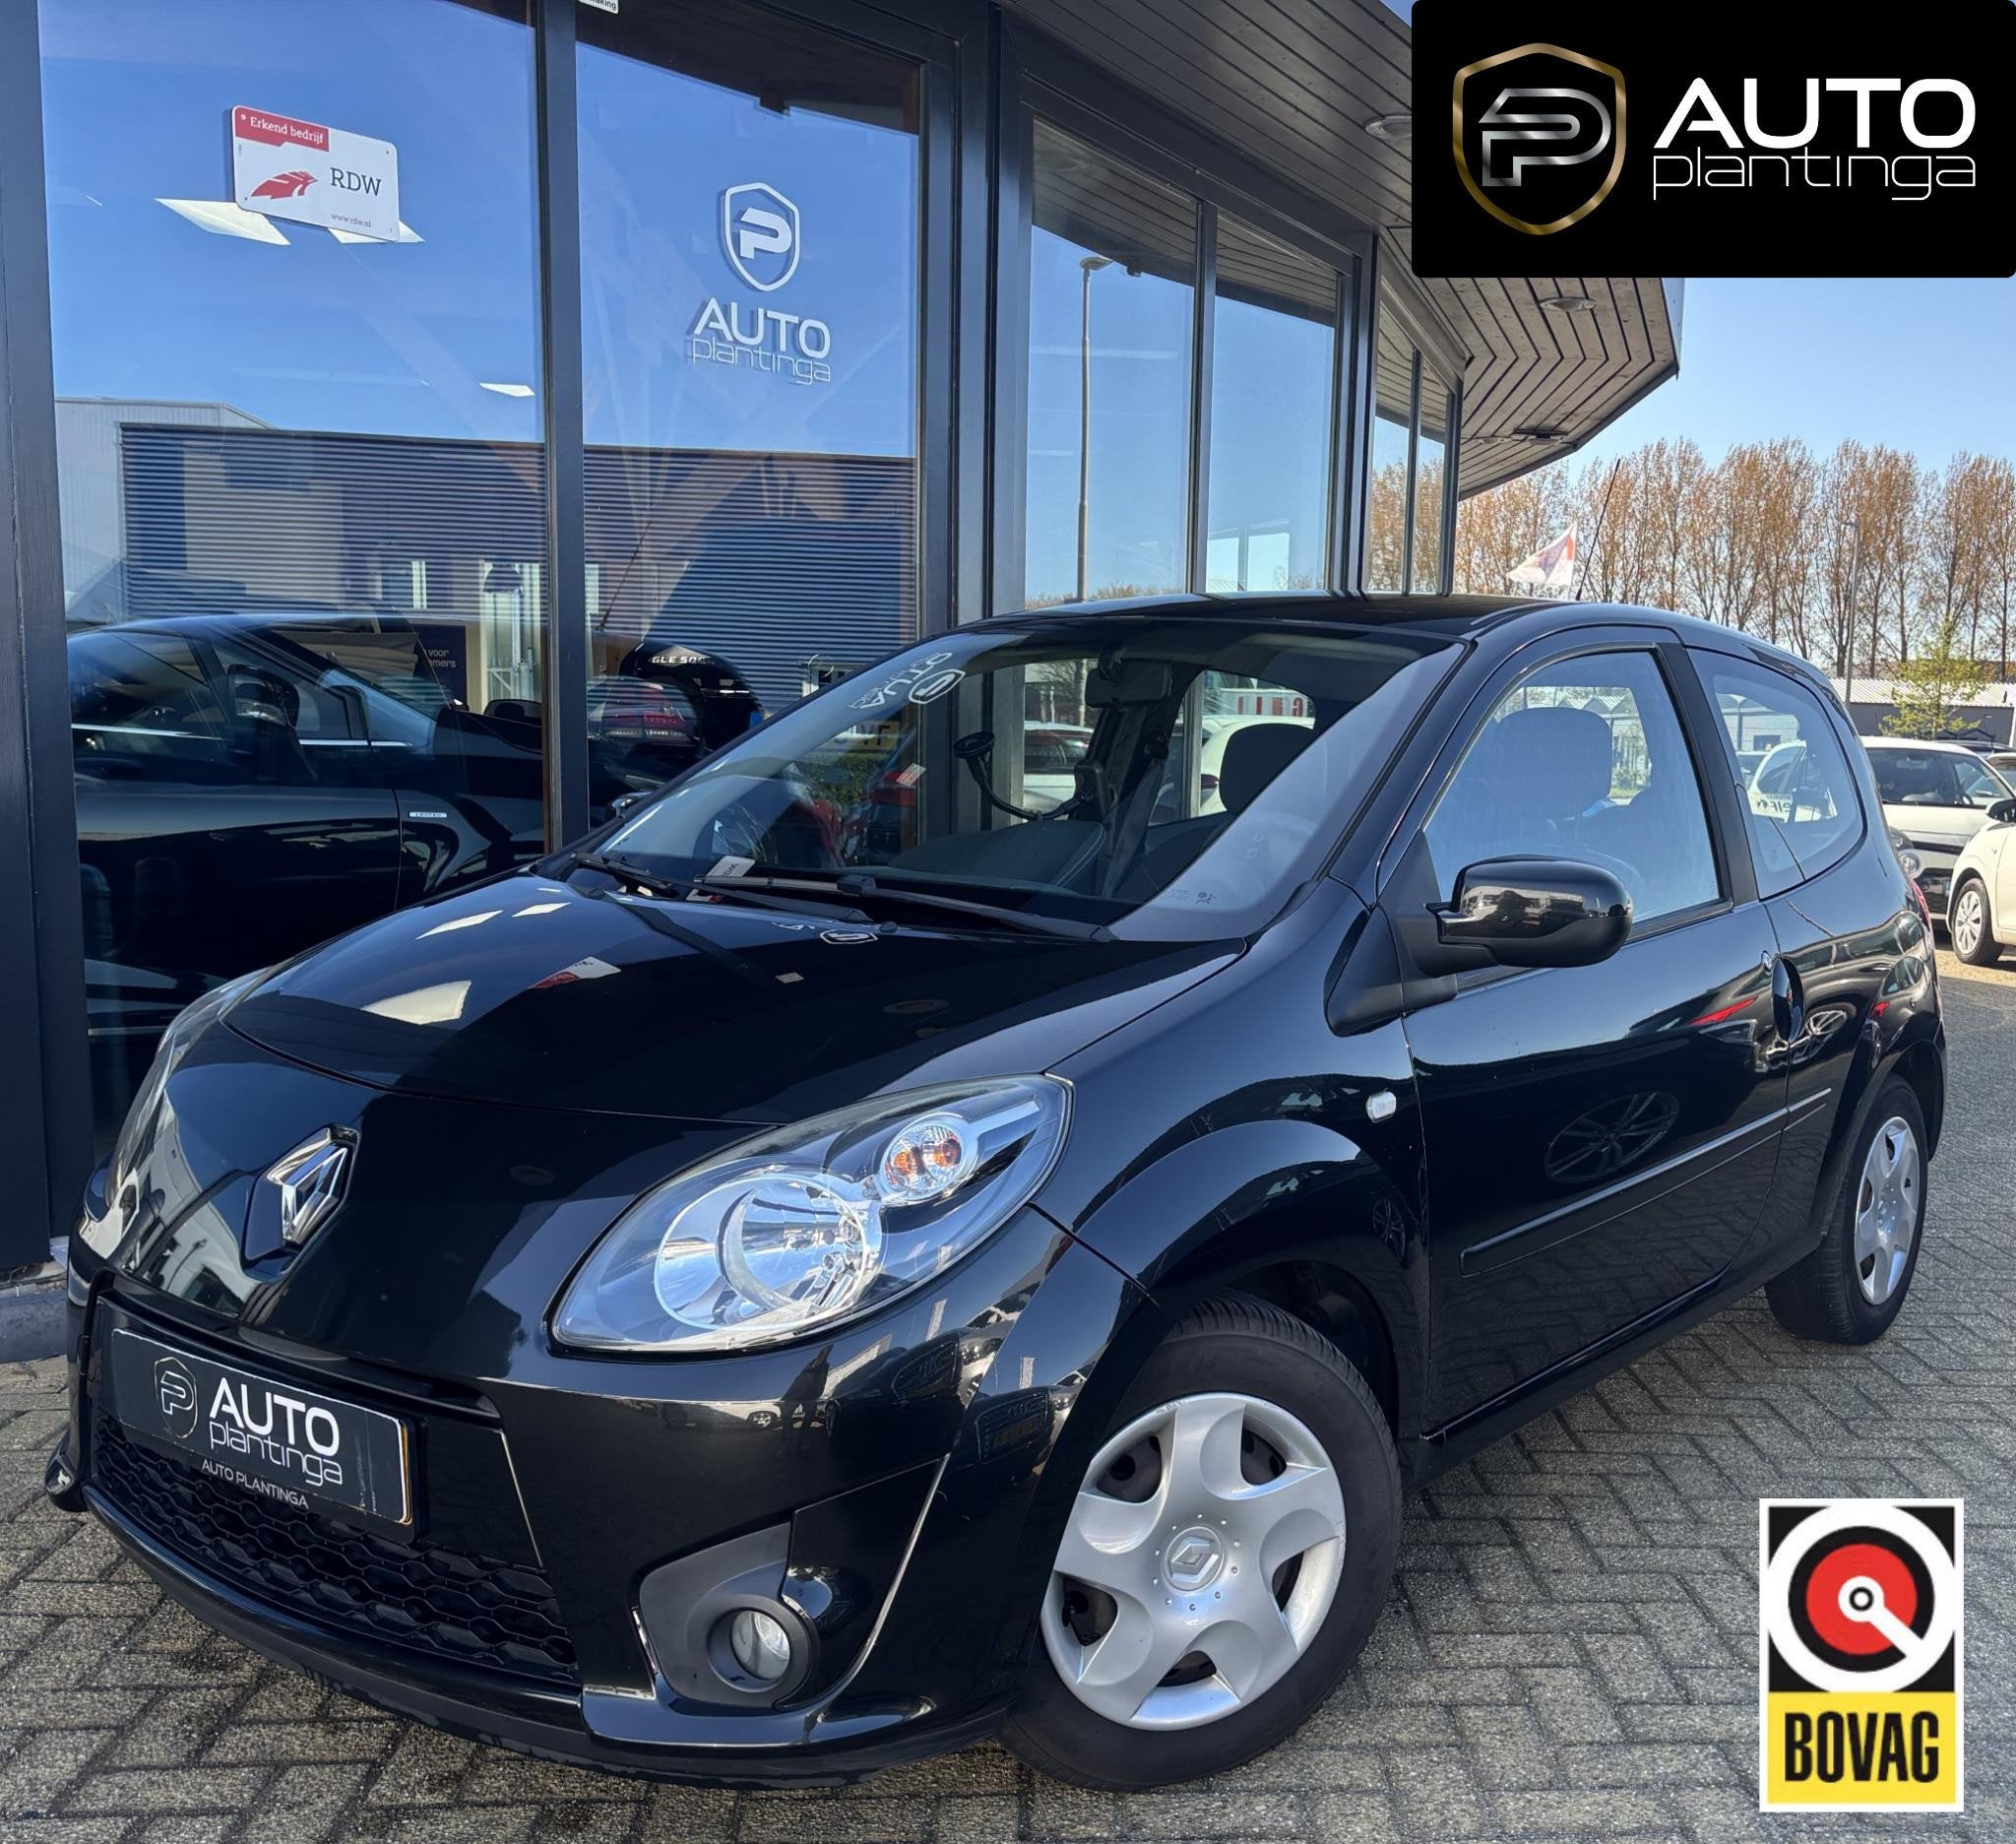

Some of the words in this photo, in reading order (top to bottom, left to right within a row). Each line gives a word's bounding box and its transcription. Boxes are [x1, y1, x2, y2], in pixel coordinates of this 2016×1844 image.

[250, 116, 287, 135] Erkend
[290, 126, 324, 145] bedrijf
[331, 167, 382, 196] RDW
[331, 213, 372, 228] www.rdw.nl
[693, 297, 831, 359] AUTO
[692, 338, 831, 385] plantinga
[427, 649, 450, 658] voor
[652, 656, 677, 665] GLE
[210, 1377, 340, 1457] AUTO
[210, 1421, 343, 1487] plantinga
[202, 1459, 234, 1482] AUTO
[236, 1470, 309, 1510] PLANTINGA
